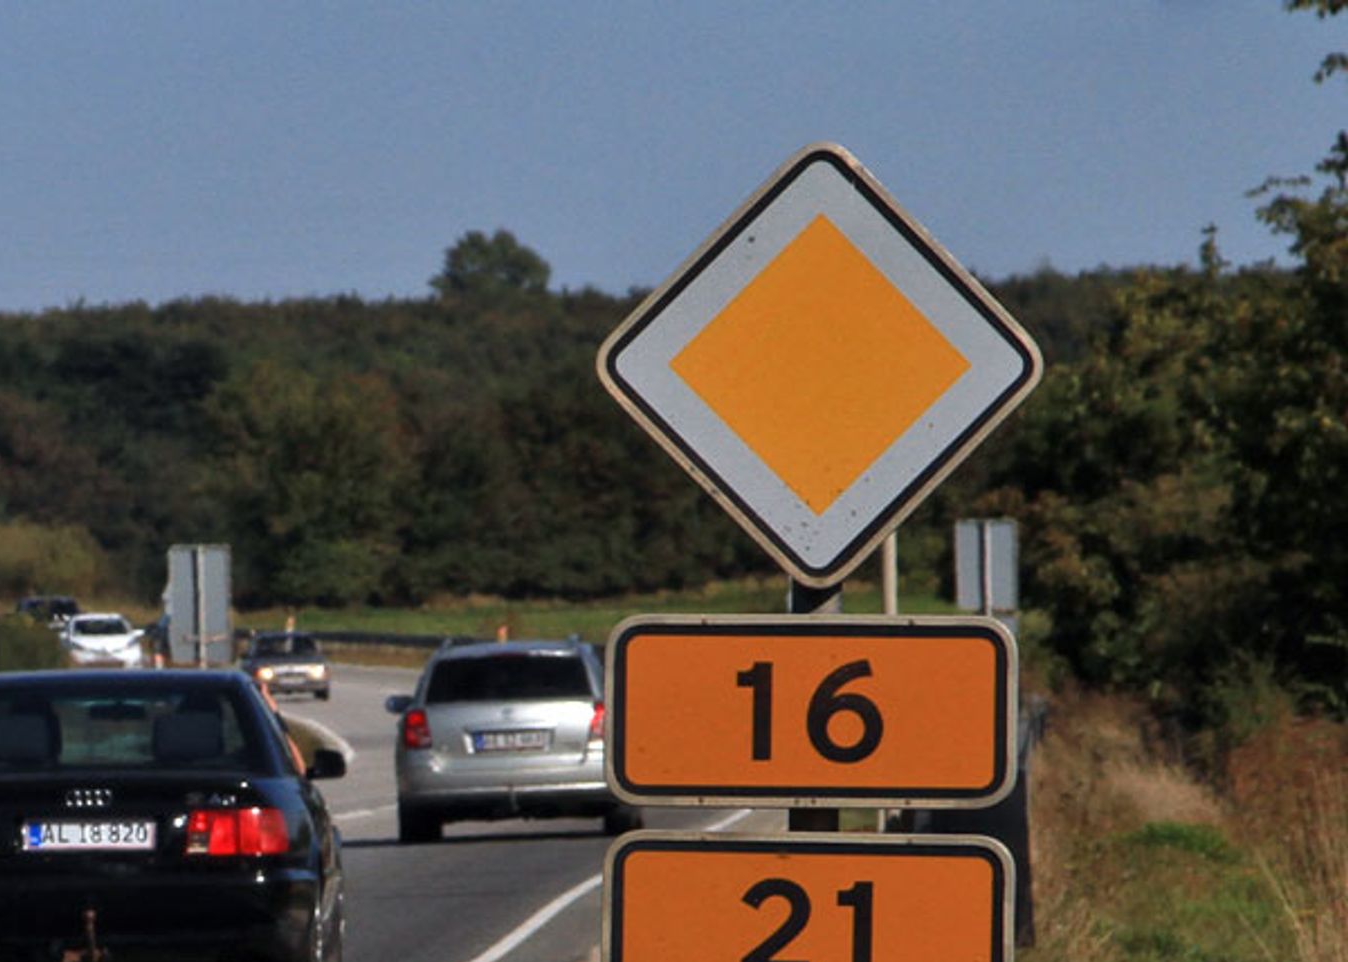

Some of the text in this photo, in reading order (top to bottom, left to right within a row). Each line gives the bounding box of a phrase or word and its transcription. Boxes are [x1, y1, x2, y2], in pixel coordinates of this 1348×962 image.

[735, 659, 883, 764] 16
[43, 824, 69, 844] AL
[108, 823, 148, 844] 820
